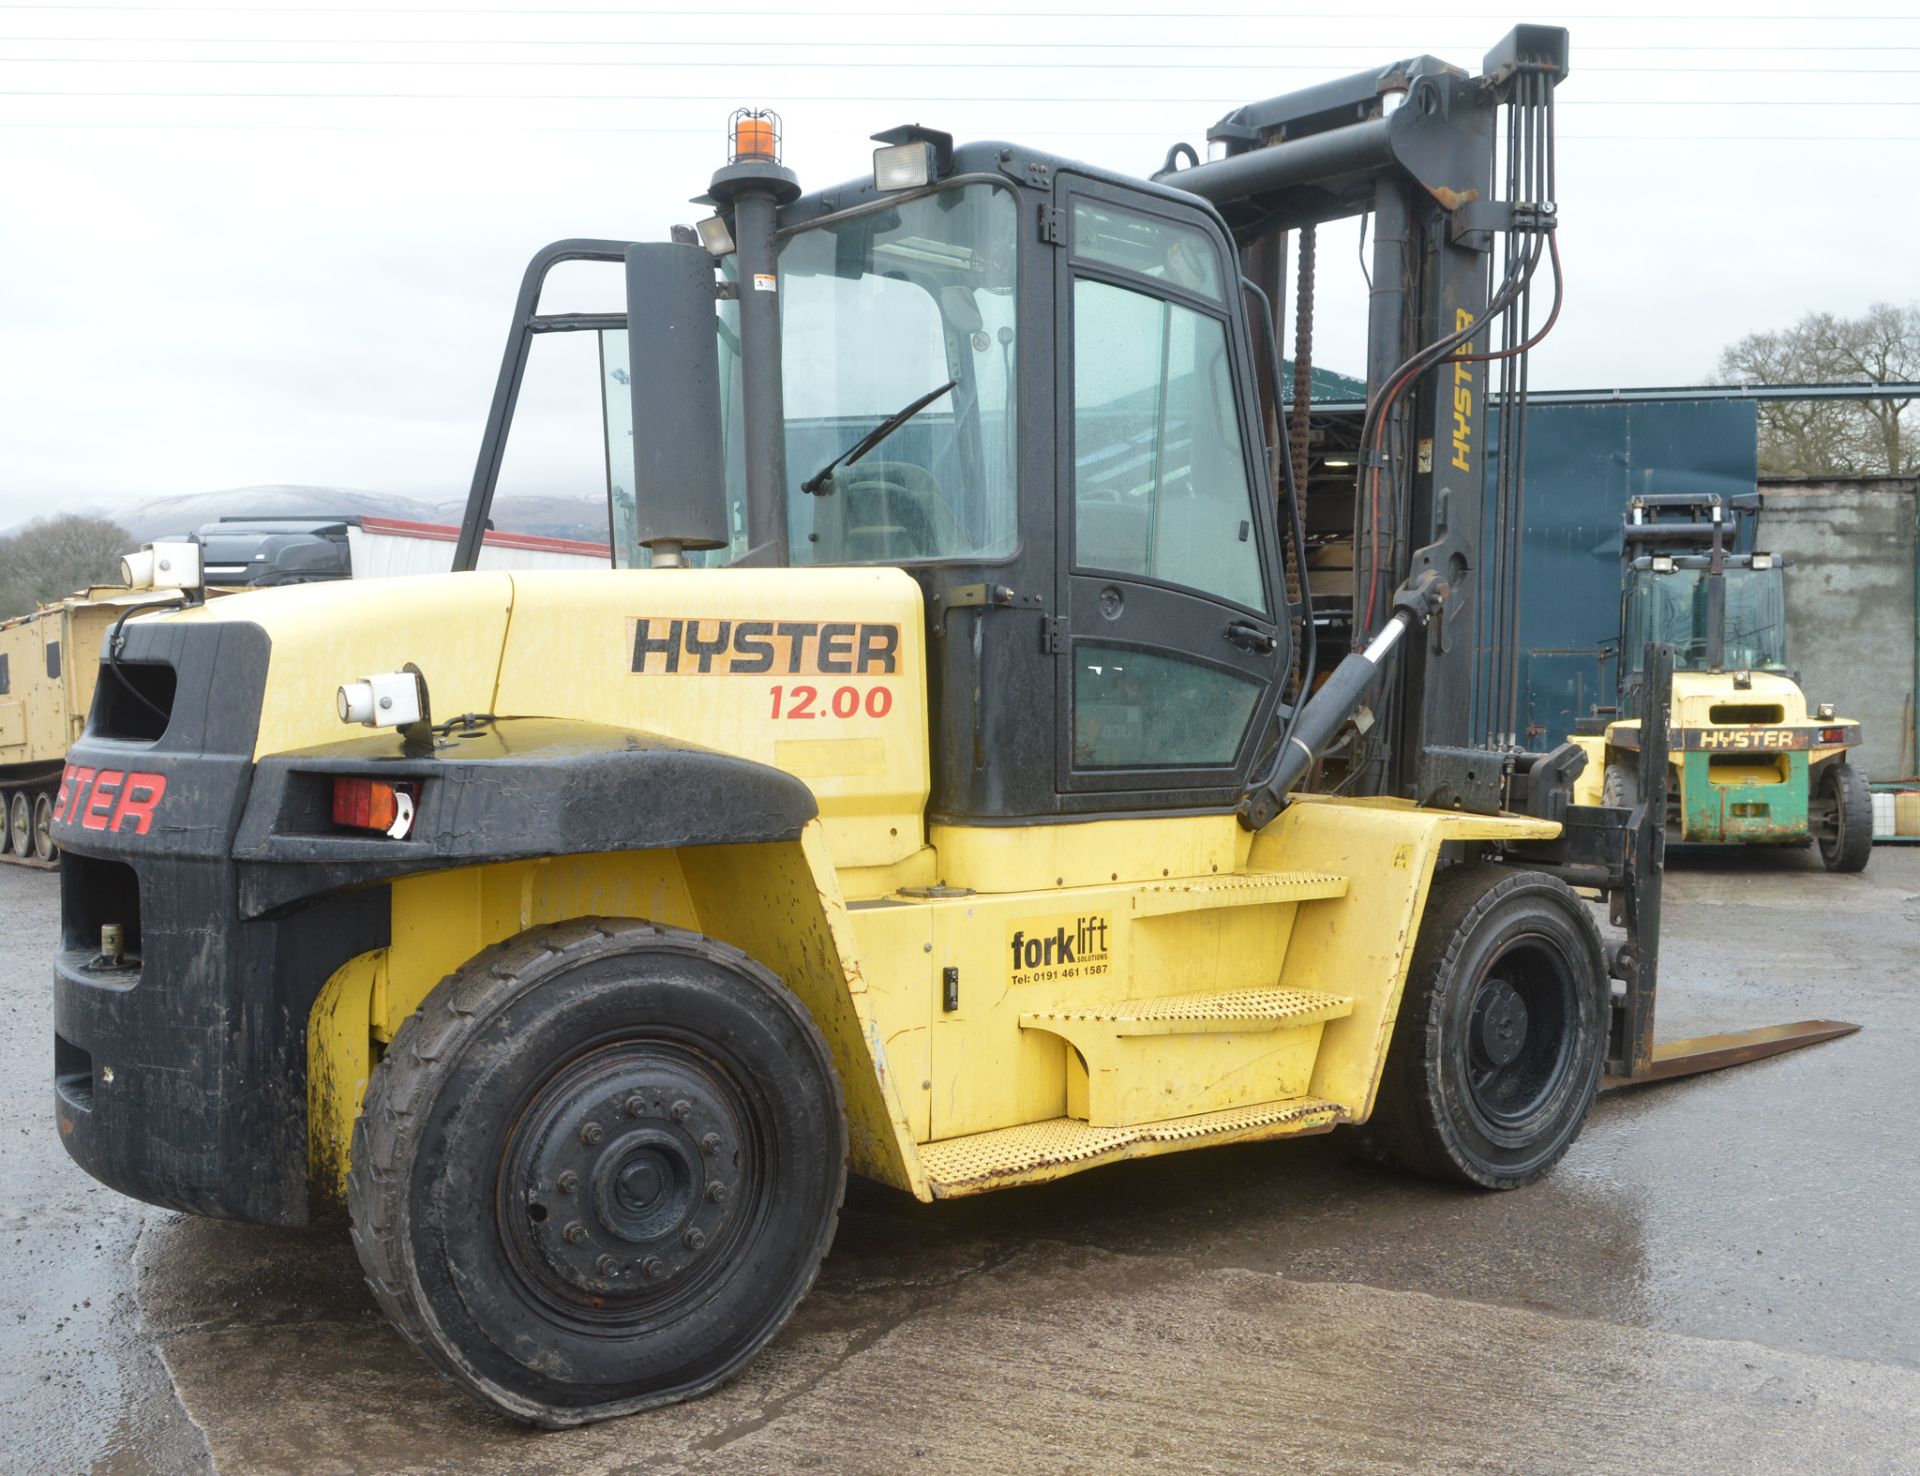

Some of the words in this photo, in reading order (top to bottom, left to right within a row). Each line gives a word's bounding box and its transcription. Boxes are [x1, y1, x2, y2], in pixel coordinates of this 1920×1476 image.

[631, 618, 899, 674] HYSTER
[769, 685, 894, 720] 12.00
[1699, 730, 1794, 748] HYSTER
[1011, 916, 1108, 970] forklift
[1077, 953, 1108, 963] SOLUTIONS
[1011, 975, 1031, 985] Tel:
[1034, 970, 1058, 982] 0191
[1062, 967, 1079, 978] 461
[1084, 964, 1108, 976] 1587
